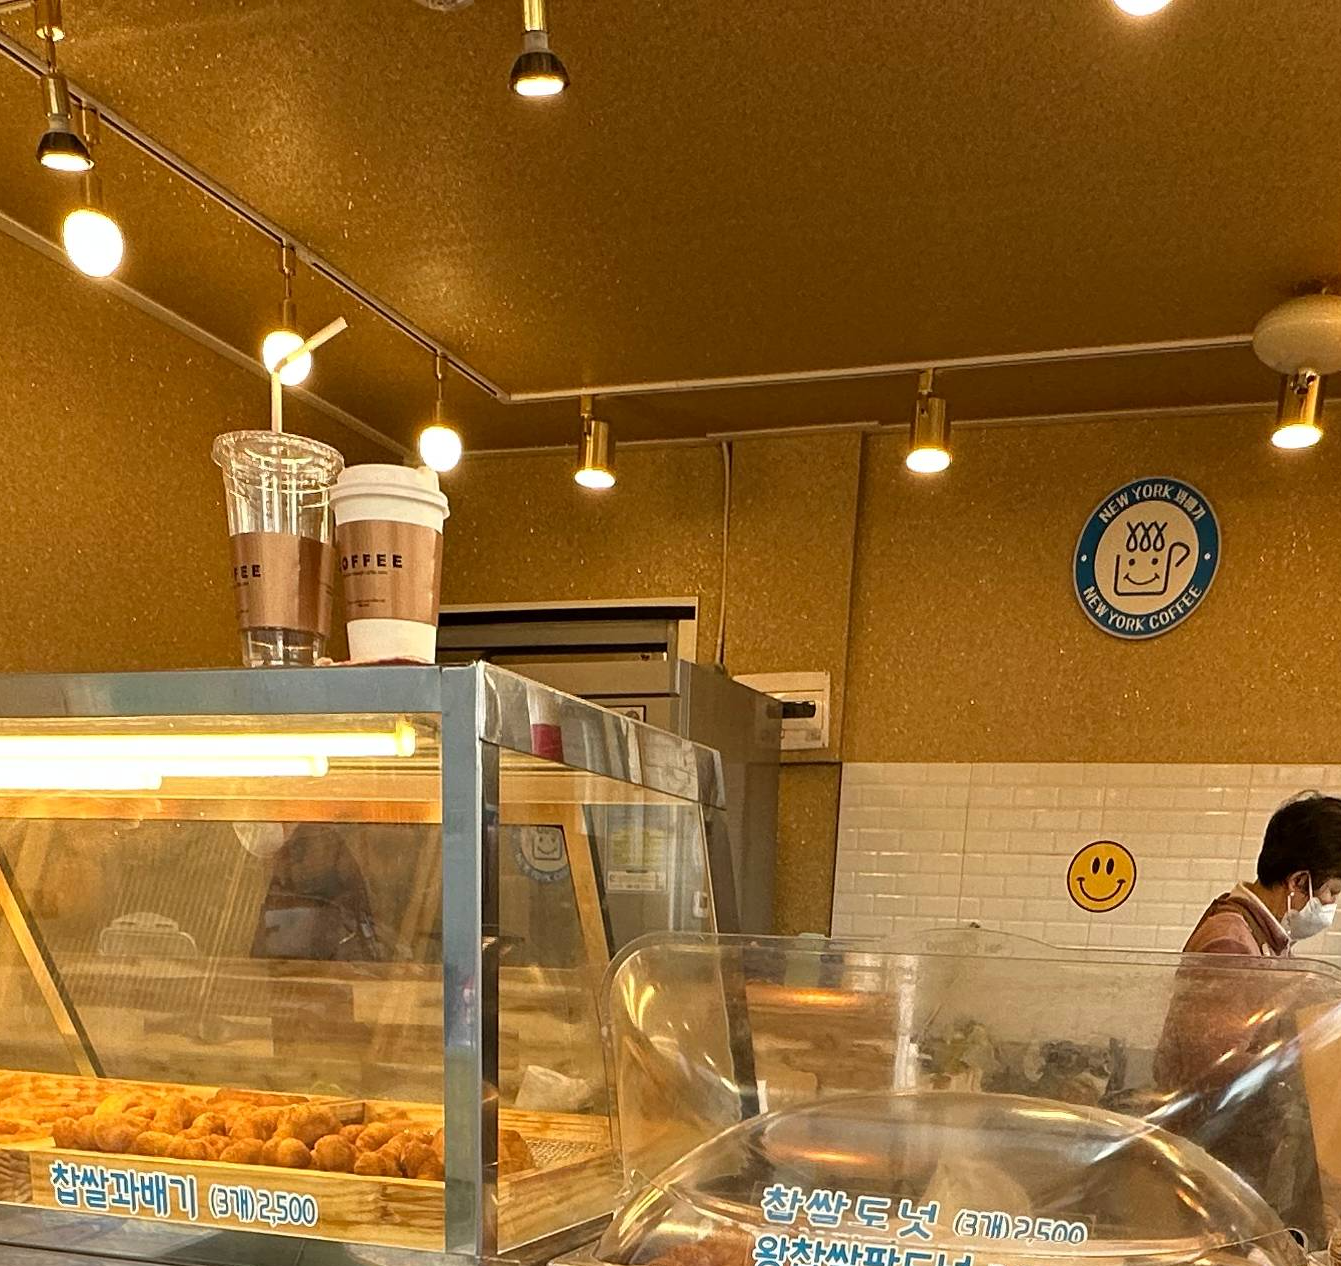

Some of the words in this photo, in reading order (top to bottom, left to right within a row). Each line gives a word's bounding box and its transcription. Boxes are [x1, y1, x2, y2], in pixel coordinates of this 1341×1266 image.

[1099, 492, 1128, 523] NEW
[1132, 484, 1175, 500] YORK
[1083, 586, 1108, 617] NEW
[1108, 611, 1144, 631] YORK
[1149, 584, 1202, 629] COFFEE
[50, 1161, 198, 1220] 찹쌀꽈배기
[209, 1184, 256, 1222] (3개)
[258, 1192, 317, 1227] 2,500
[953, 1211, 1011, 1240] (3개)
